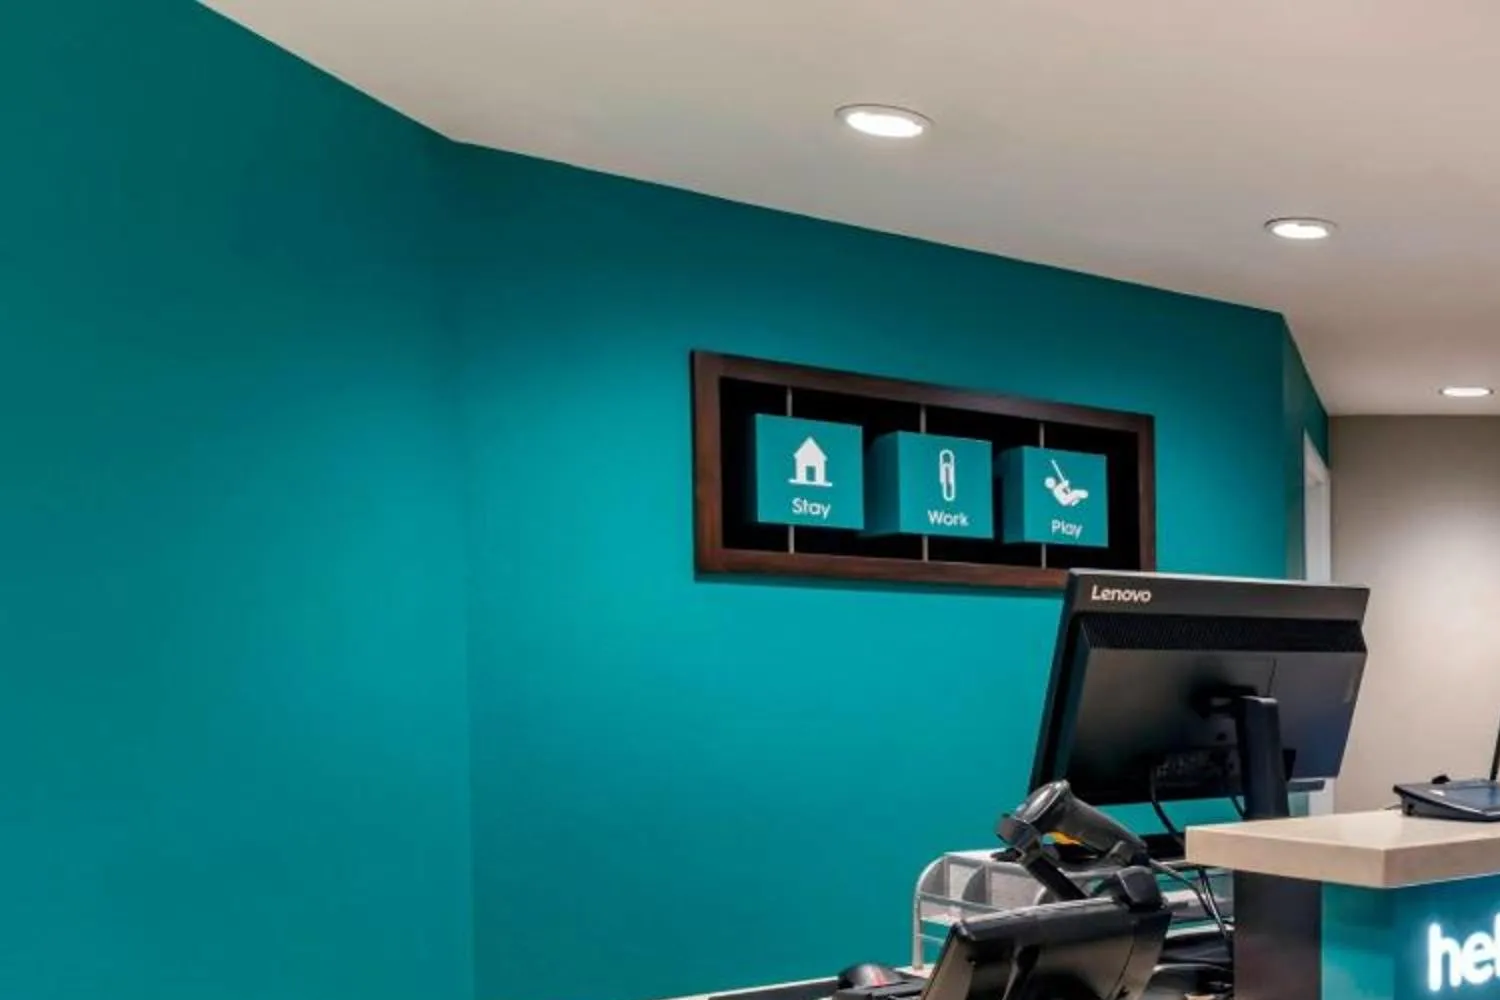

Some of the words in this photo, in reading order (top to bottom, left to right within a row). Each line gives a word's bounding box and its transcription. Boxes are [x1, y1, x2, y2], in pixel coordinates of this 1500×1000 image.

[791, 497, 831, 519] Stay
[927, 509, 969, 528] Work
[1050, 518, 1084, 539] Play
[1091, 585, 1152, 603] Lenovo
